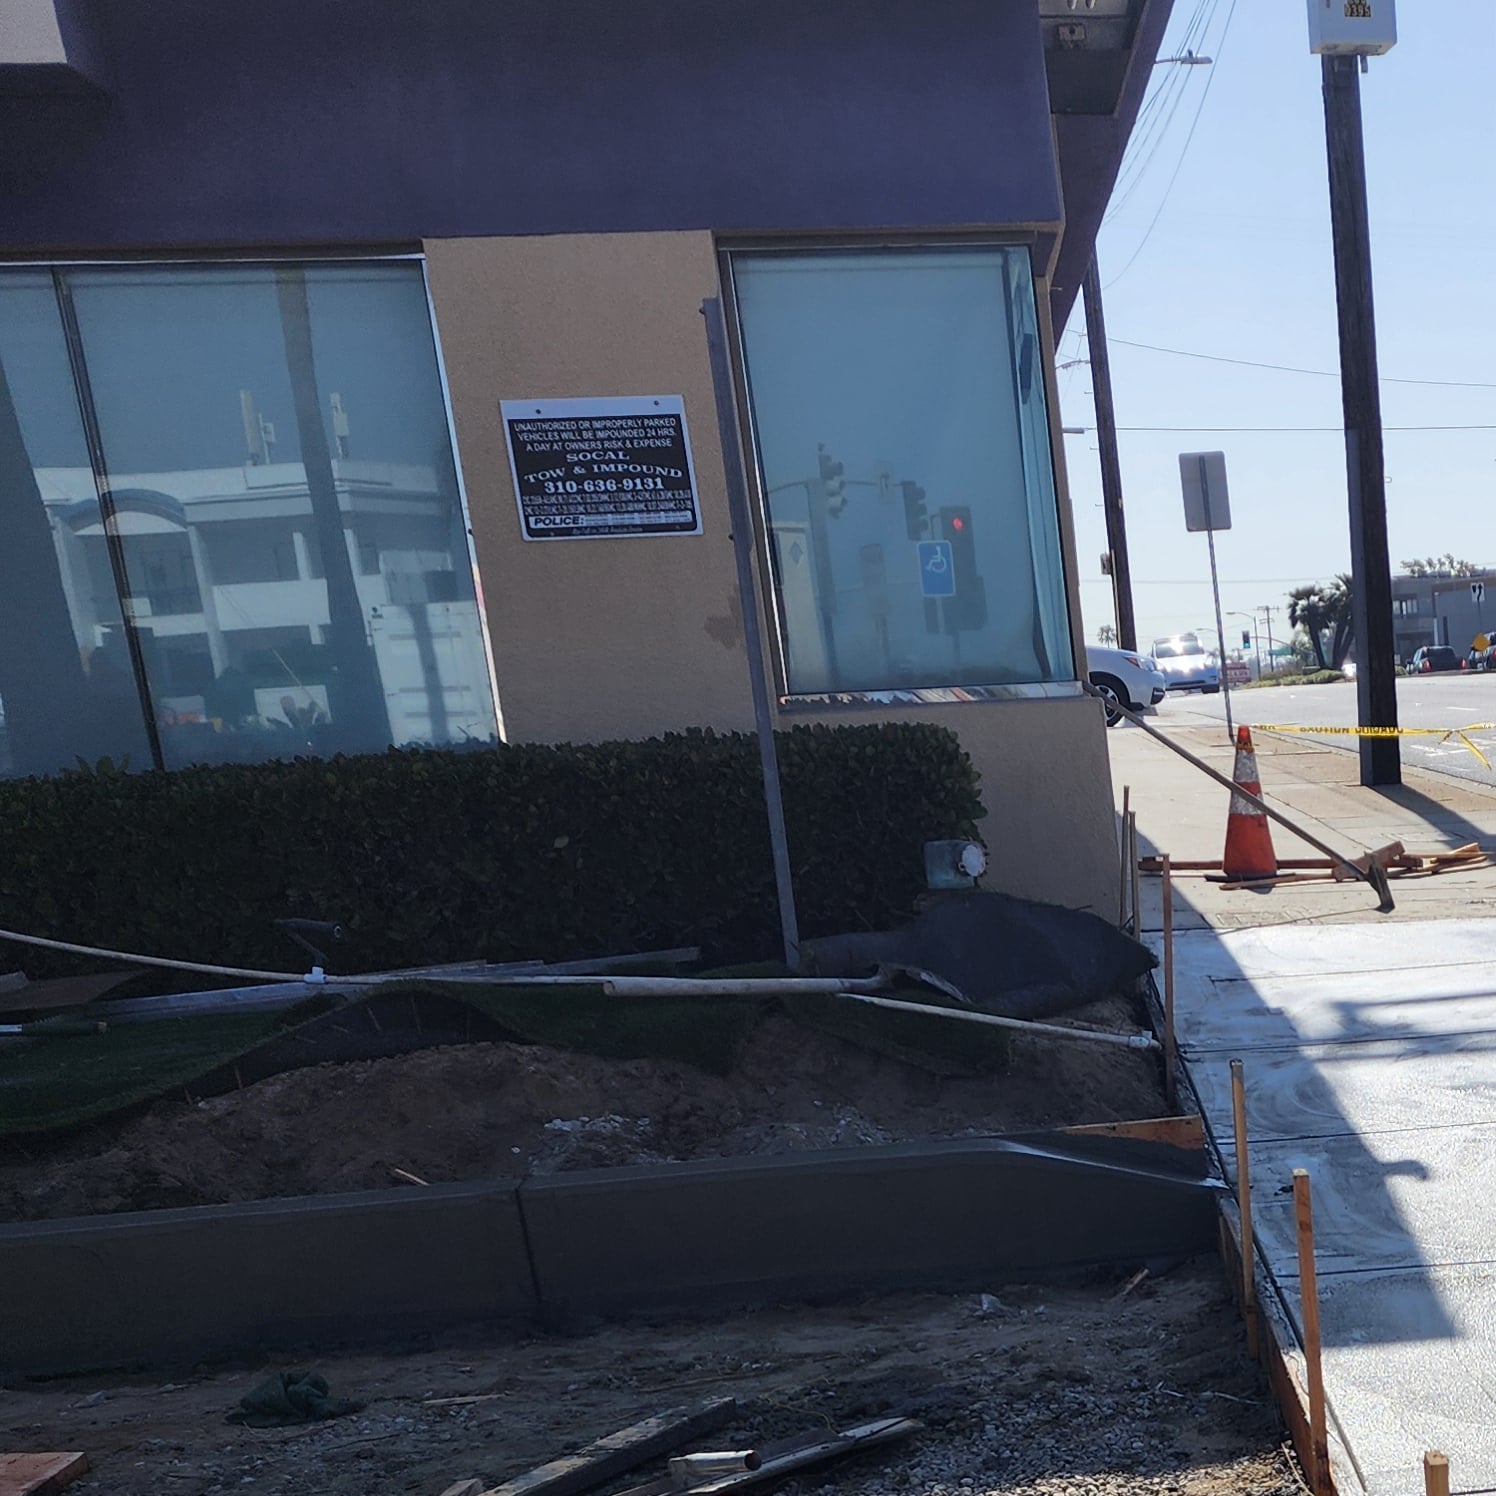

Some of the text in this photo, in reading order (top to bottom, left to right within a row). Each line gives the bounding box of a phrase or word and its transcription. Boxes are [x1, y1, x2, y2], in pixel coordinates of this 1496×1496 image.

[514, 418, 676, 431] UNAUTHORIZED OR IMPROPERLY PARKED
[518, 432, 559, 441] VEHICLES
[561, 431, 581, 439] WILL
[583, 430, 594, 439] BE
[596, 429, 645, 438] IMPOUNDED
[647, 428, 656, 437] 24
[526, 438, 672, 451] A DAY AT OWNERS RISK & EXPENSE
[566, 451, 630, 463] SOCAL
[524, 464, 683, 482] TOW & IMPOUND
[544, 477, 665, 494] 310-636-9131
[534, 516, 584, 527] POLICE:
